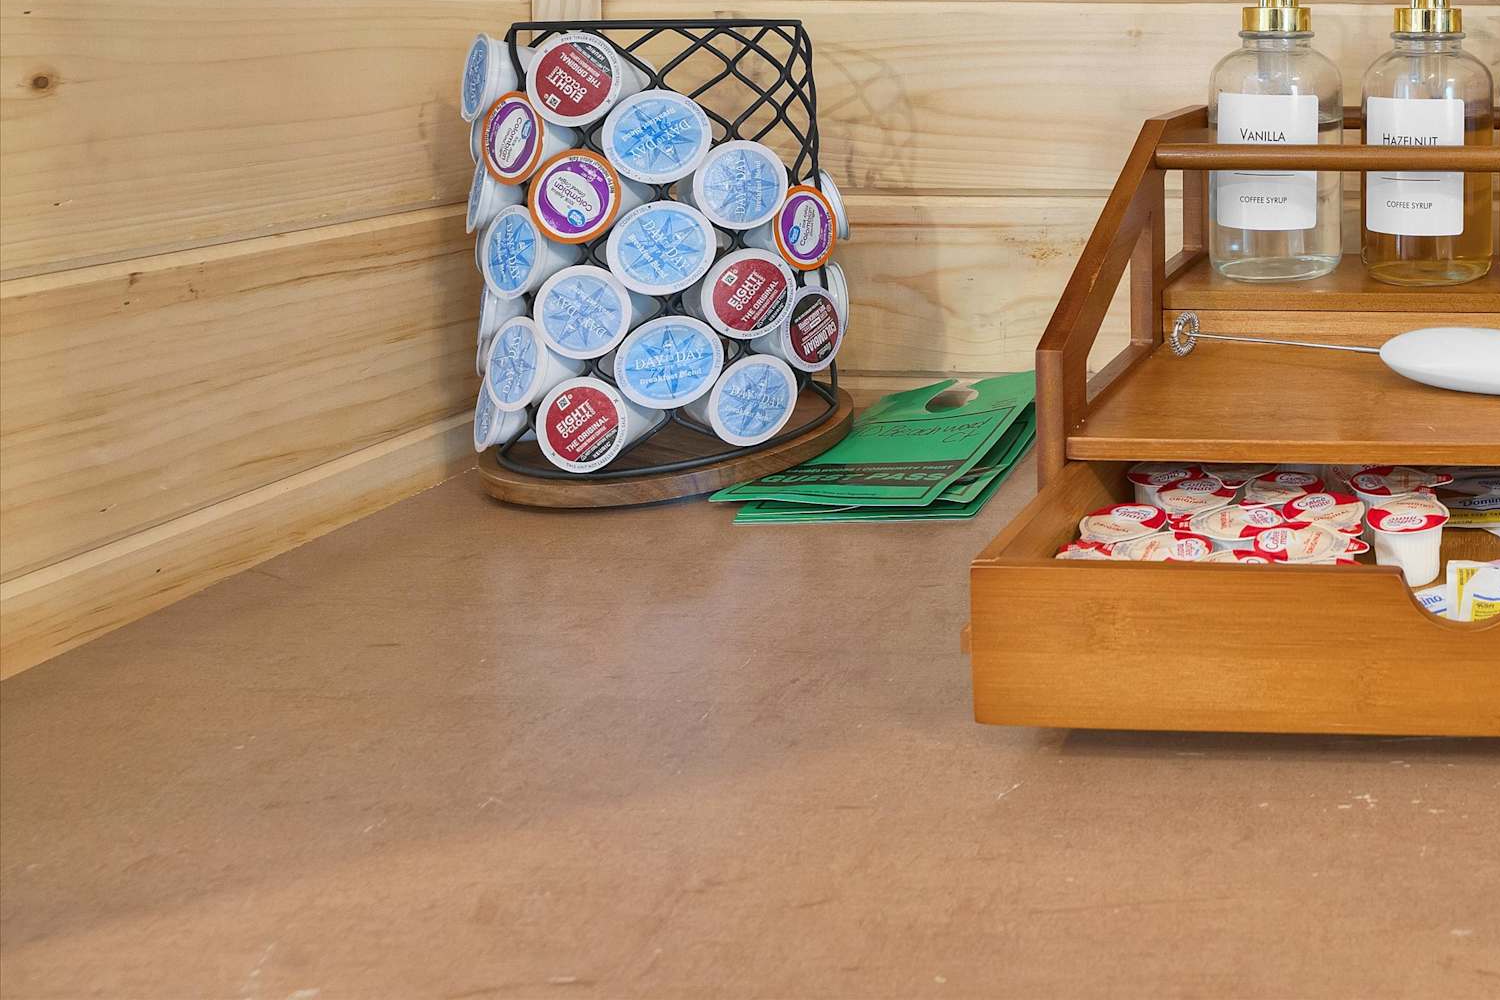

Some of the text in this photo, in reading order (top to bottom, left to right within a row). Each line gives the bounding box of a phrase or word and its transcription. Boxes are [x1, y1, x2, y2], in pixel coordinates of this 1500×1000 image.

[560, 52, 589, 78] ORIGINAL
[547, 74, 584, 103] EIGHT
[557, 67, 588, 95] O'CLOCK
[586, 76, 602, 88] THE
[1239, 128, 1286, 142] VANILLA
[1382, 133, 1439, 146] HAZELNUT
[553, 181, 593, 212] Colombian
[1239, 195, 1265, 204] COFFEE
[1386, 200, 1433, 210] COFFEE SYRUP
[727, 273, 758, 308] EIGHT
[735, 276, 766, 311] O'CLOCK
[741, 308, 755, 322] THE
[753, 280, 779, 310] ORIGINAL
[634, 354, 665, 370] DAY
[676, 347, 705, 363] DAY
[556, 401, 588, 434] EIGHT
[562, 410, 594, 439] O'CLOCK
[565, 440, 580, 452] THE
[577, 416, 609, 443] ORIGINAL
[760, 472, 947, 483] GUEST PASS
